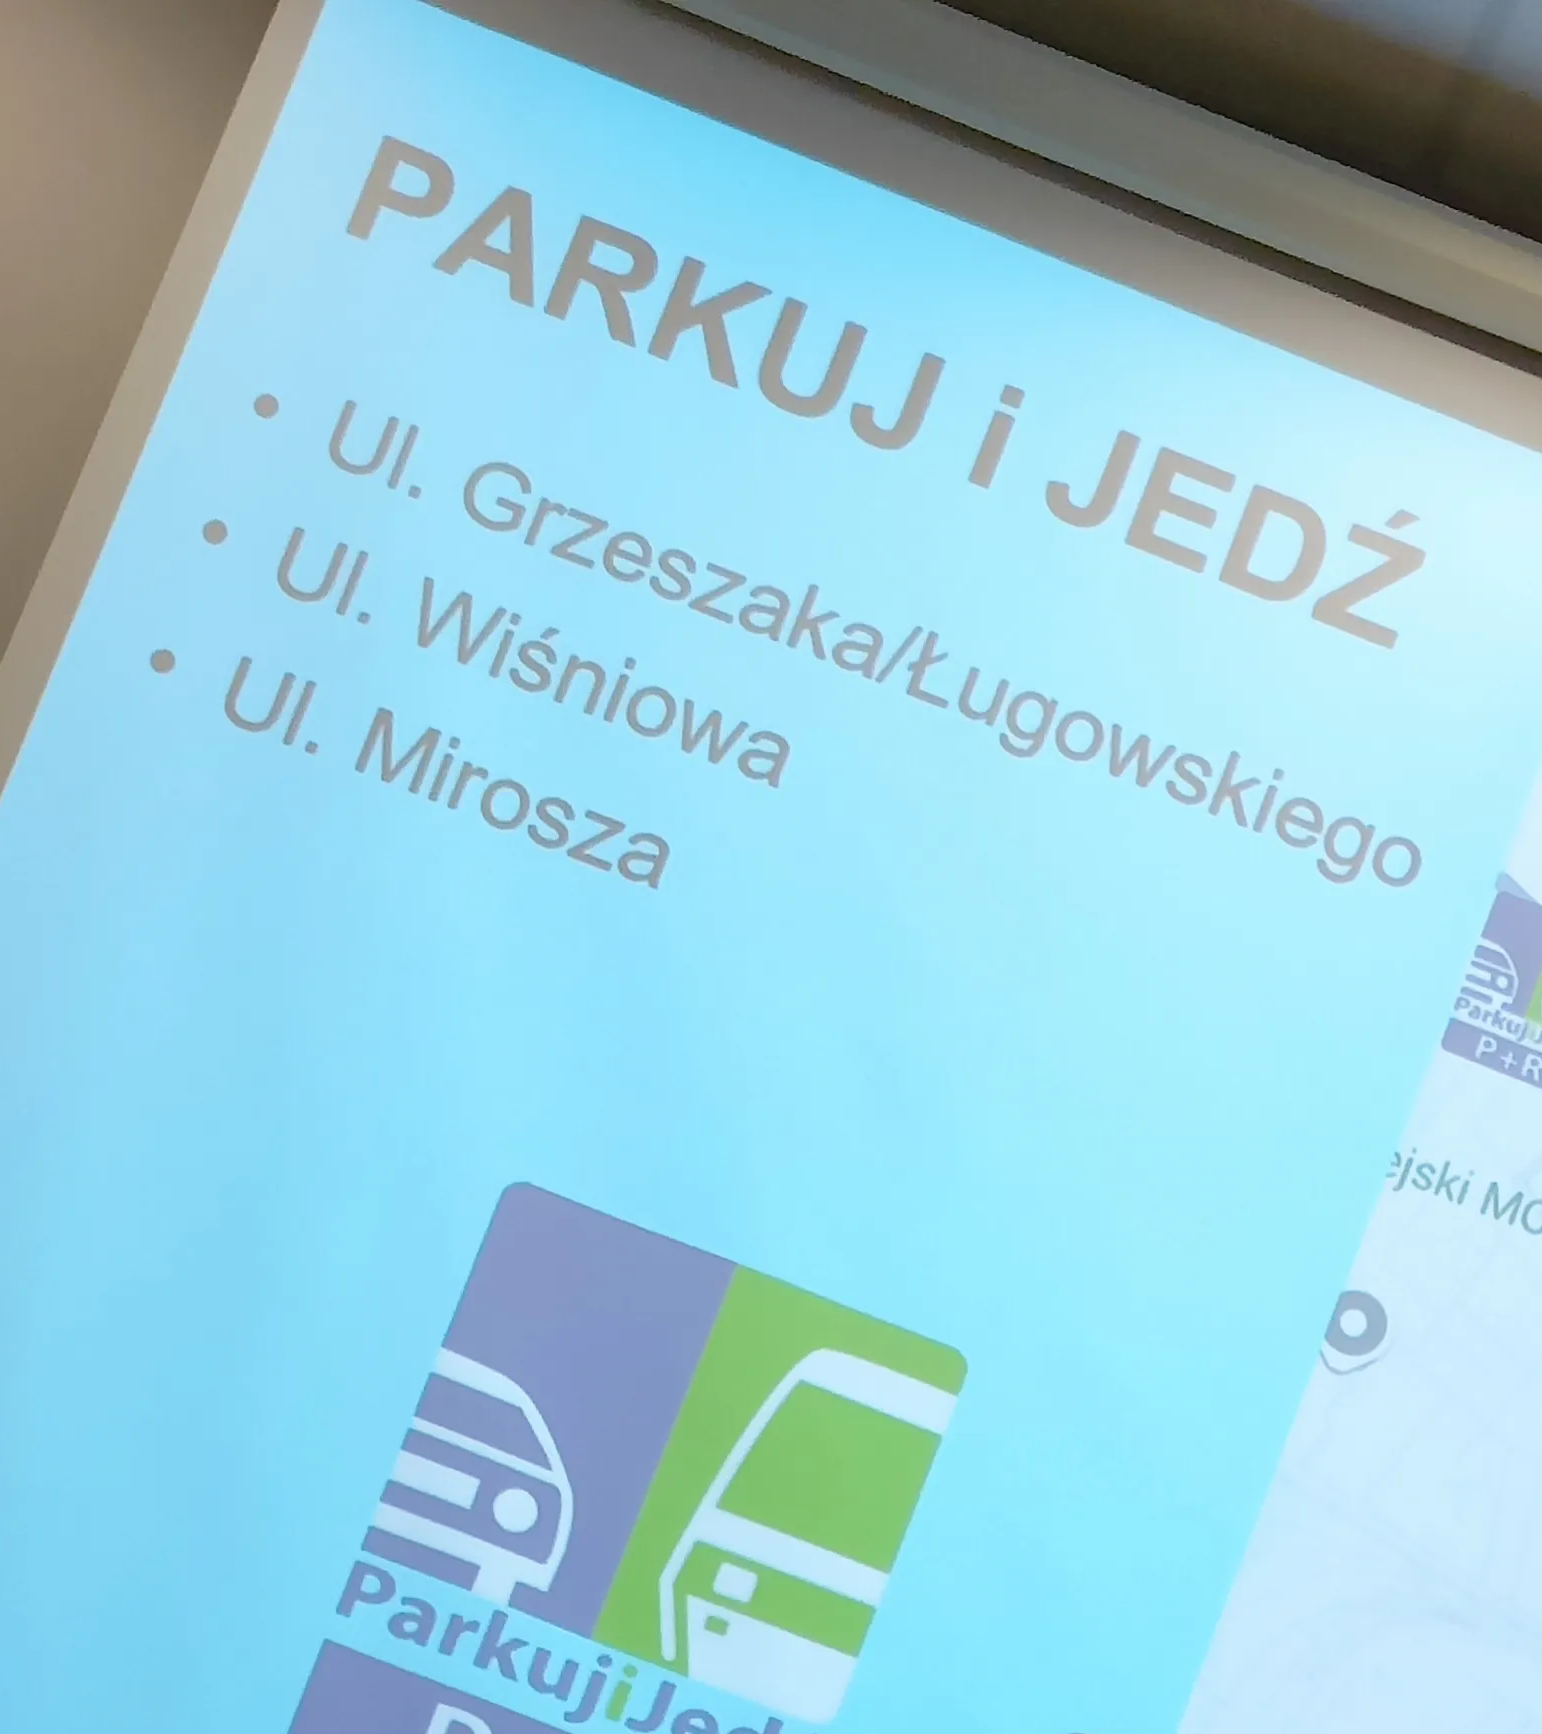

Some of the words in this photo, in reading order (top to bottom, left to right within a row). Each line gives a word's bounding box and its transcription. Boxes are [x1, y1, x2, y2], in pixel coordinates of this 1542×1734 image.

[345, 134, 945, 450] PARKUJ
[968, 385, 1025, 488] i
[1045, 430, 1426, 648] JEDŹ
[224, 655, 319, 753] Ul.
[355, 708, 672, 889] Mirosza
[276, 527, 370, 625] Ul.
[415, 576, 791, 788] Wiśniowa
[328, 399, 422, 499] Ul.
[463, 460, 1423, 889] Grzeszaka/Ługowskiego
